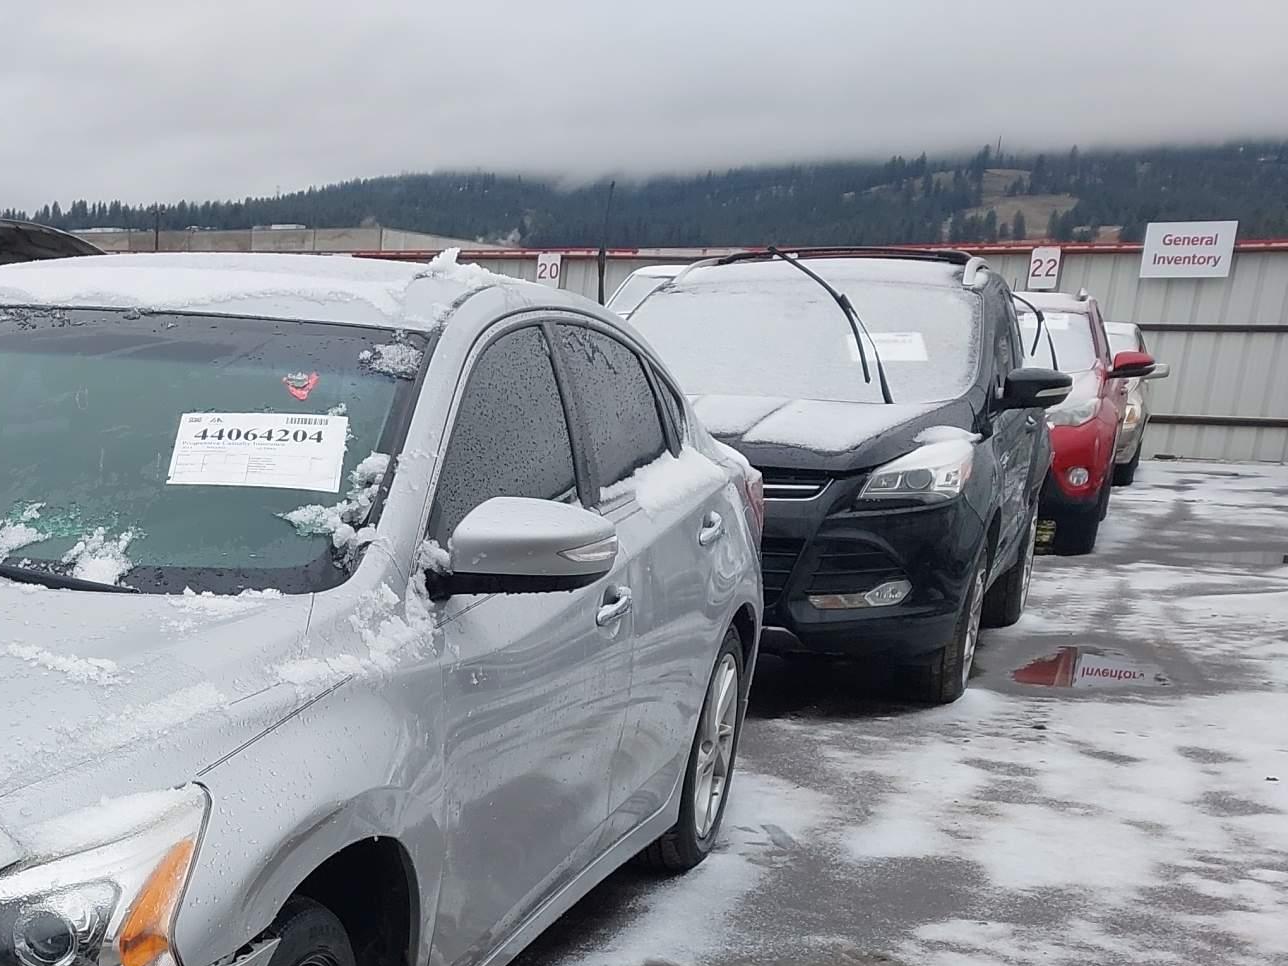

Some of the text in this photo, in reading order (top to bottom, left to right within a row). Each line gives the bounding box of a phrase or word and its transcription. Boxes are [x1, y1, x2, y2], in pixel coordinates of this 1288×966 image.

[1162, 233, 1219, 246] General
[1031, 258, 1057, 278] 22
[1152, 253, 1222, 268] Inventory
[538, 262, 559, 280] 20
[194, 428, 324, 444] 44064204
